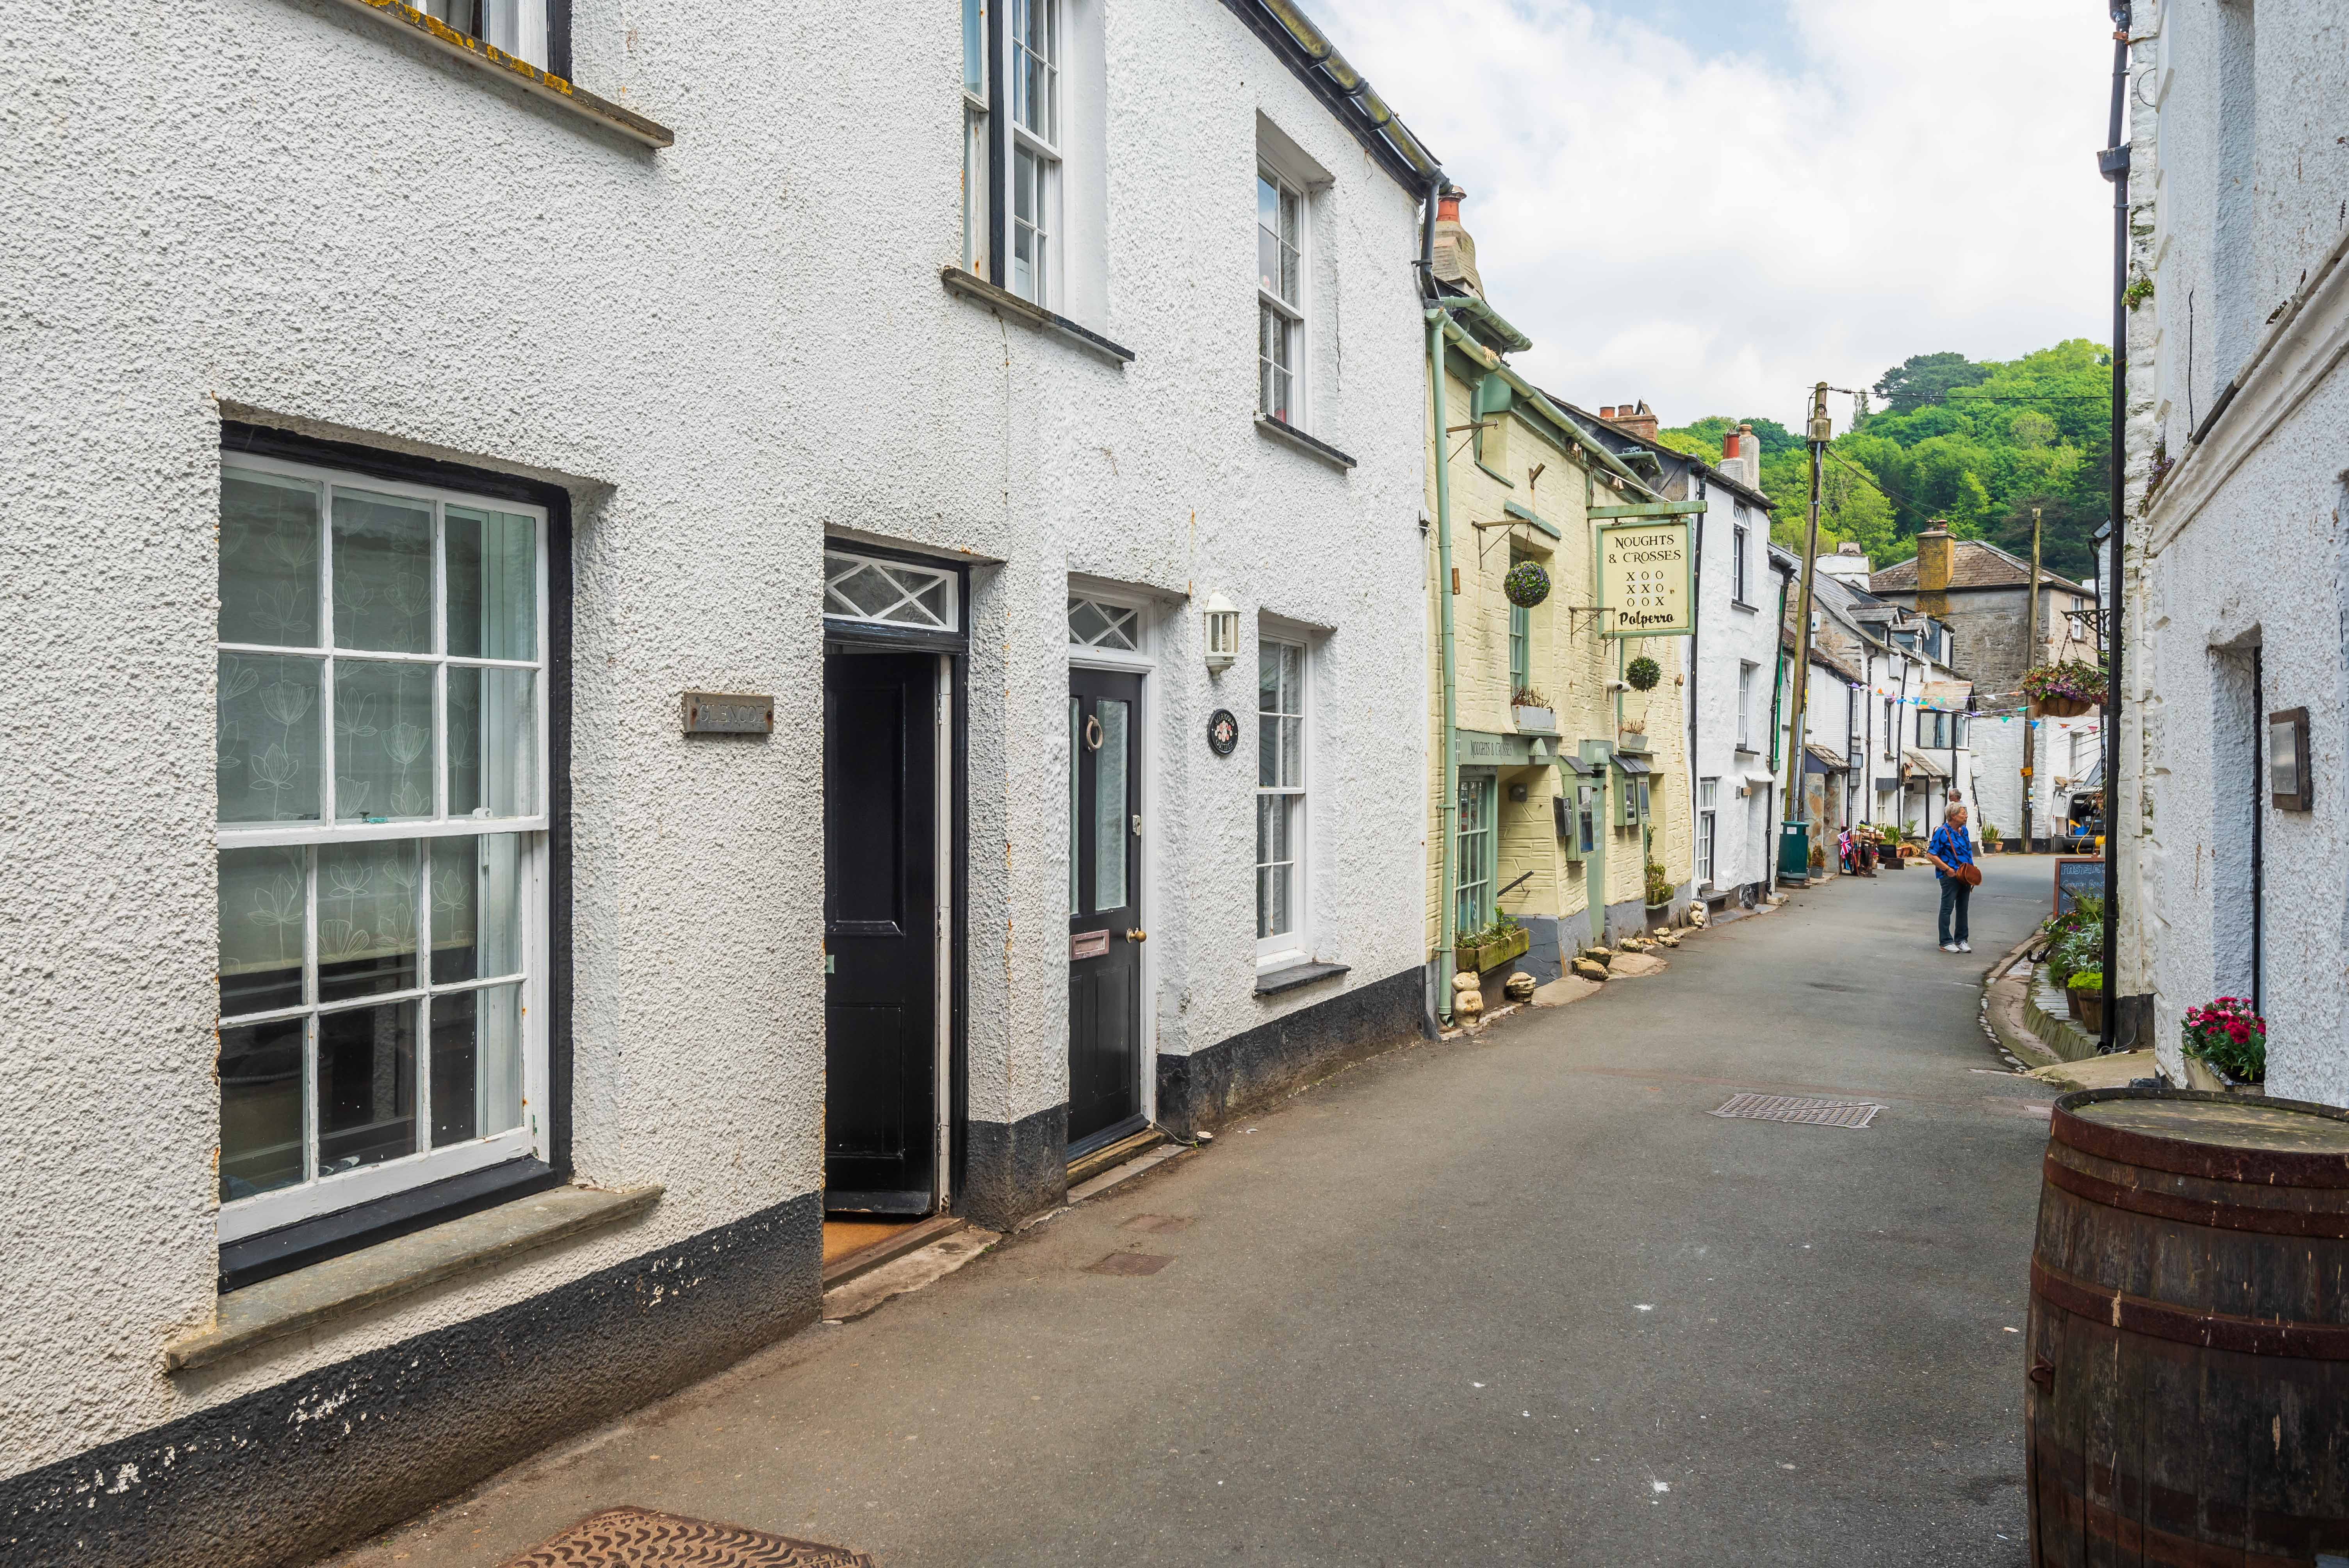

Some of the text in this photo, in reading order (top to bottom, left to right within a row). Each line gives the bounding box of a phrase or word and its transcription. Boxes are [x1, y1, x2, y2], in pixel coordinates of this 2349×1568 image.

[1615, 534, 1674, 549] NOUGHTS
[1609, 550, 1681, 564] & CROSSES
[1618, 610, 1675, 628] Polperro
[699, 704, 766, 722] GLENCOE
[1214, 713, 1235, 727] MARIGOLD
[1216, 739, 1233, 750] COTTAGE
[1470, 740, 1512, 759] NOUGHTS & CROSSES
